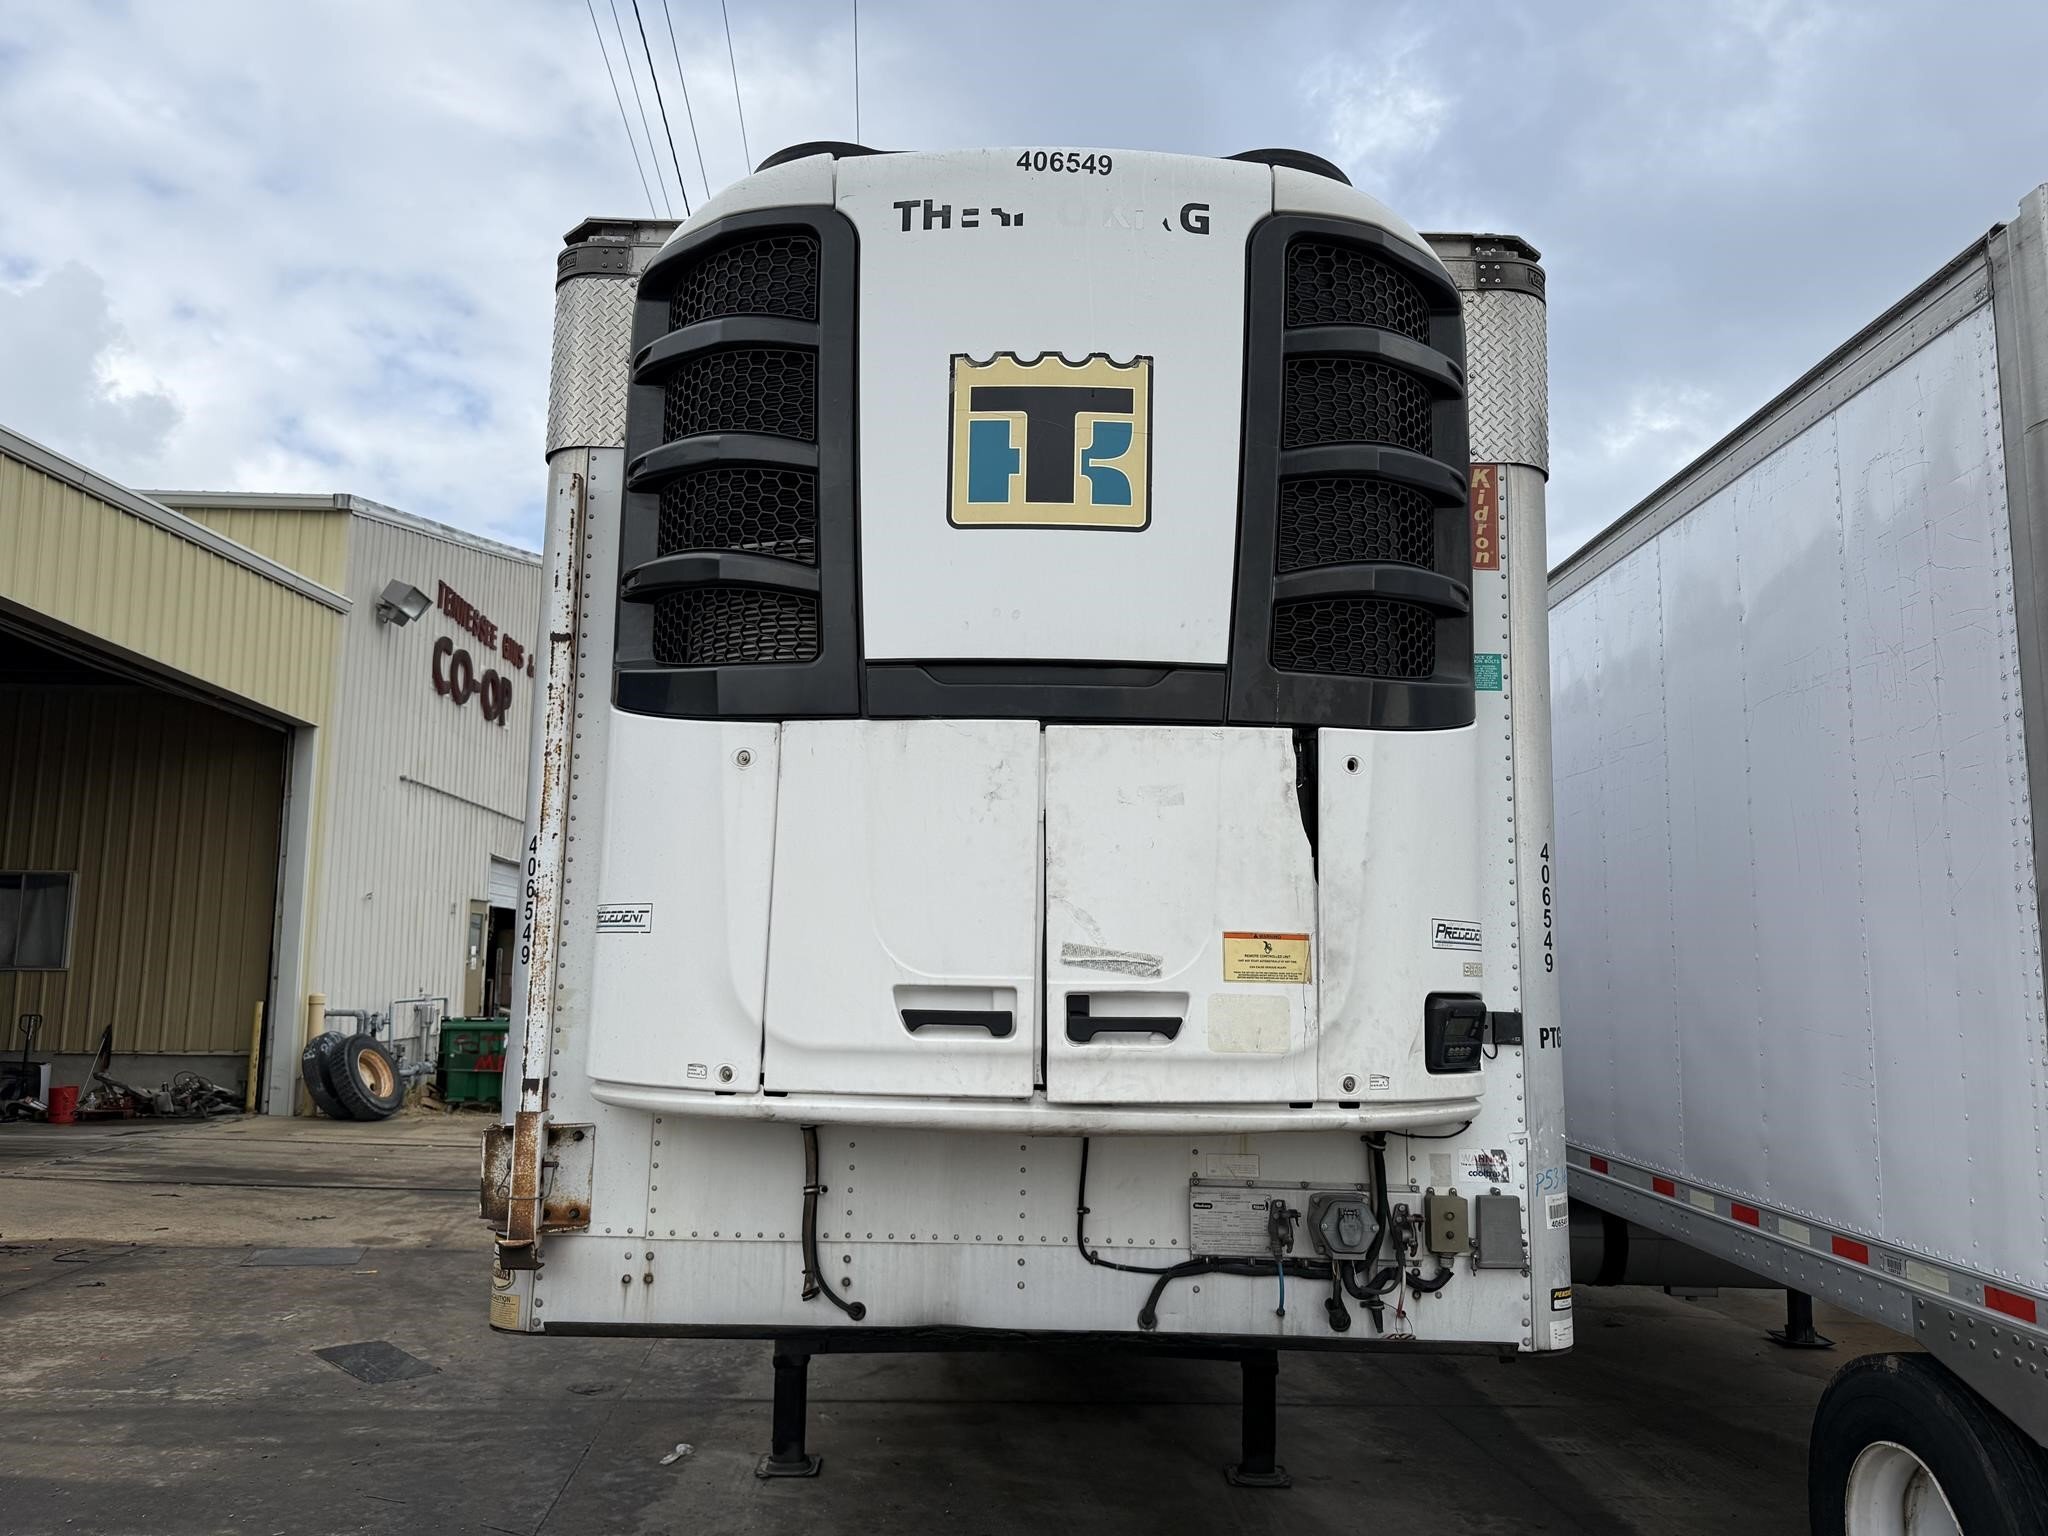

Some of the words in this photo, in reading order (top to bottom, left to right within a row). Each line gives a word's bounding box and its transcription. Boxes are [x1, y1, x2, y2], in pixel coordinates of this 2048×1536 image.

[1016, 150, 1113, 176] 406549
[1471, 468, 1491, 564] Kidron
[432, 636, 513, 727] CO-OP
[521, 835, 537, 965] 406549
[1540, 843, 1554, 973] 406549
